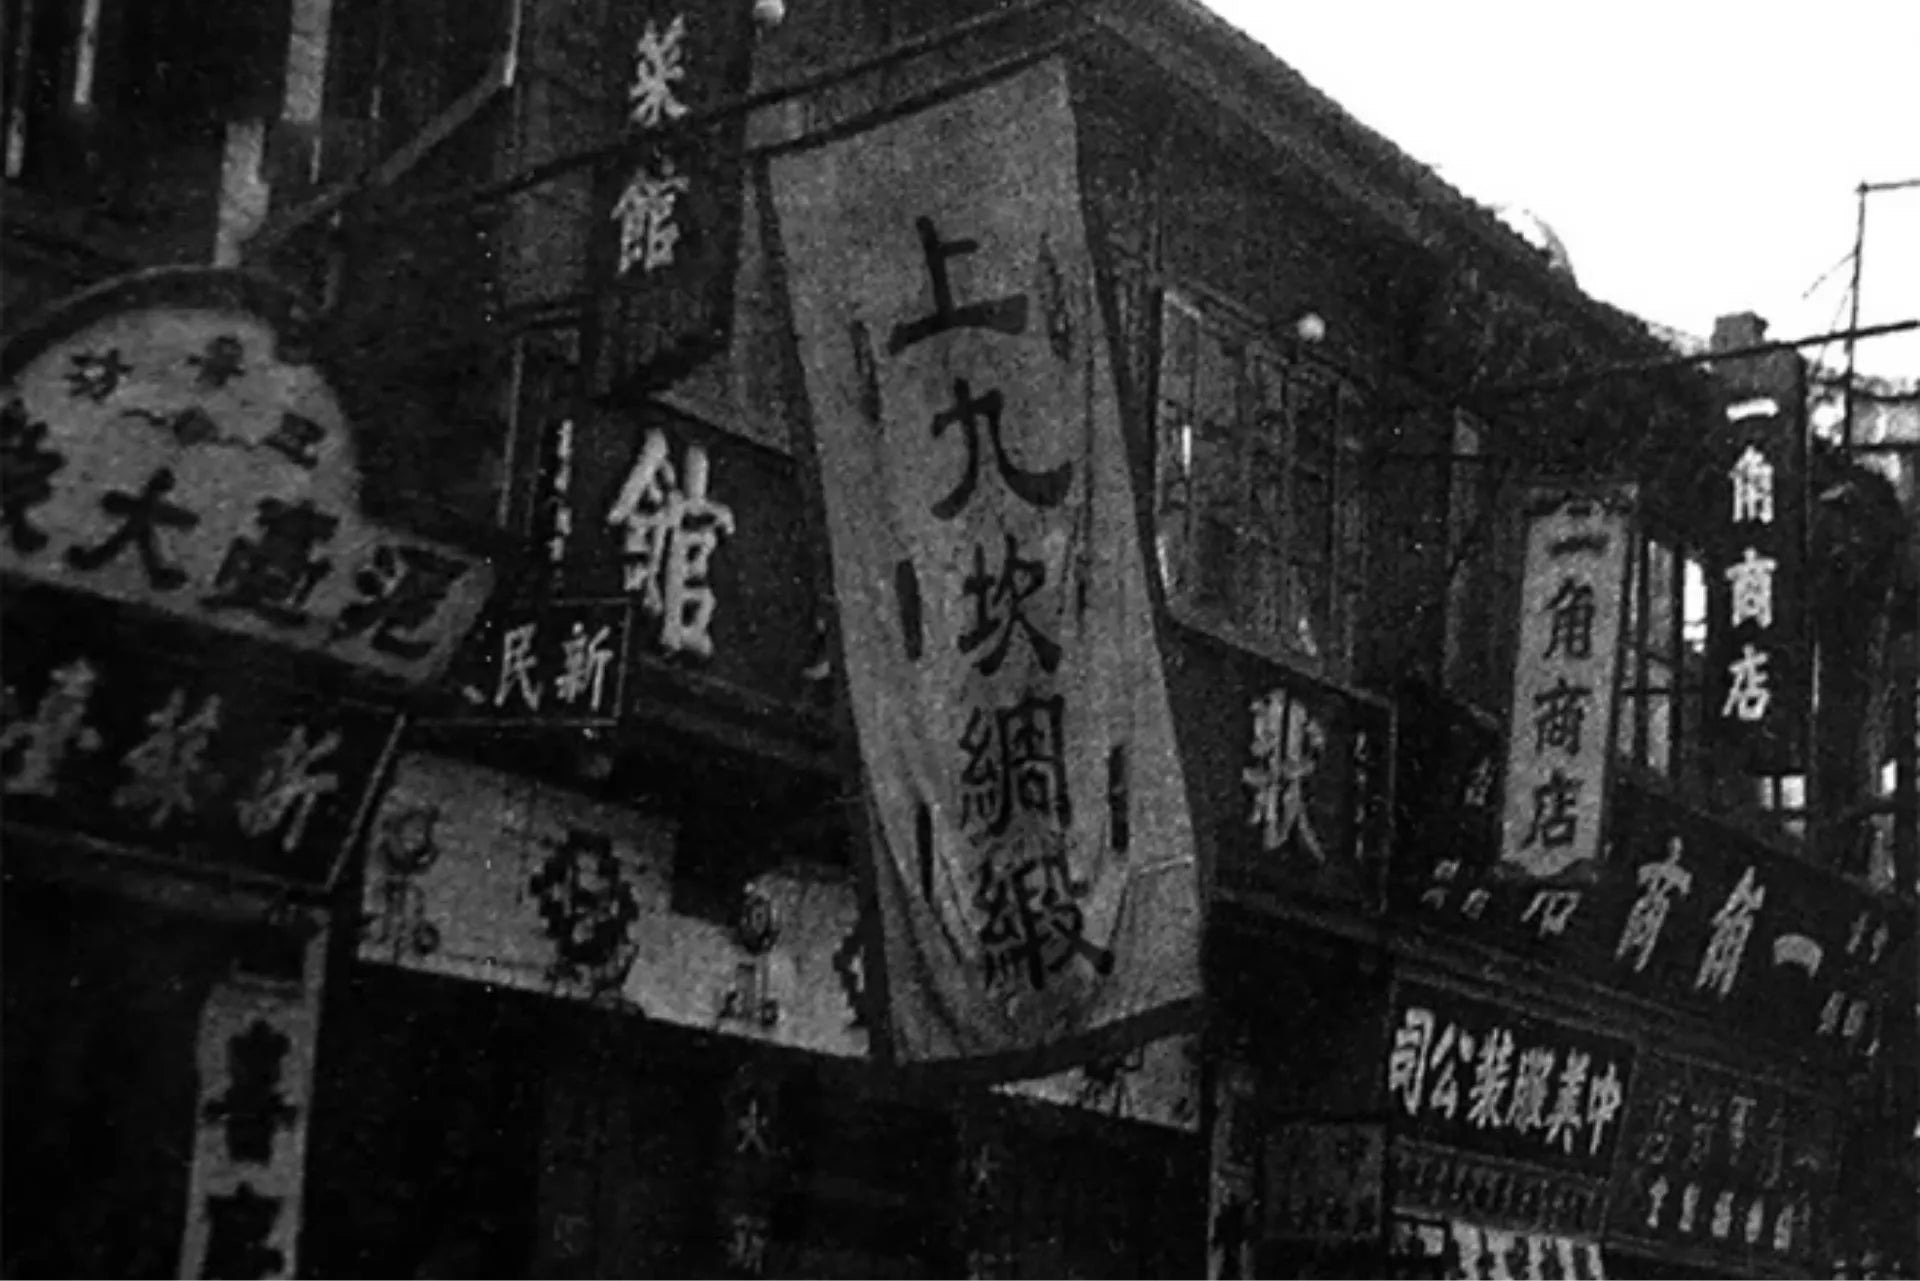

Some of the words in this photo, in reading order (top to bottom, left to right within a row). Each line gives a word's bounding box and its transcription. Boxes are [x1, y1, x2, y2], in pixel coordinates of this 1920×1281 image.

[1523, 534, 1608, 850] 一角商店
[1721, 397, 1781, 722] 一角商店
